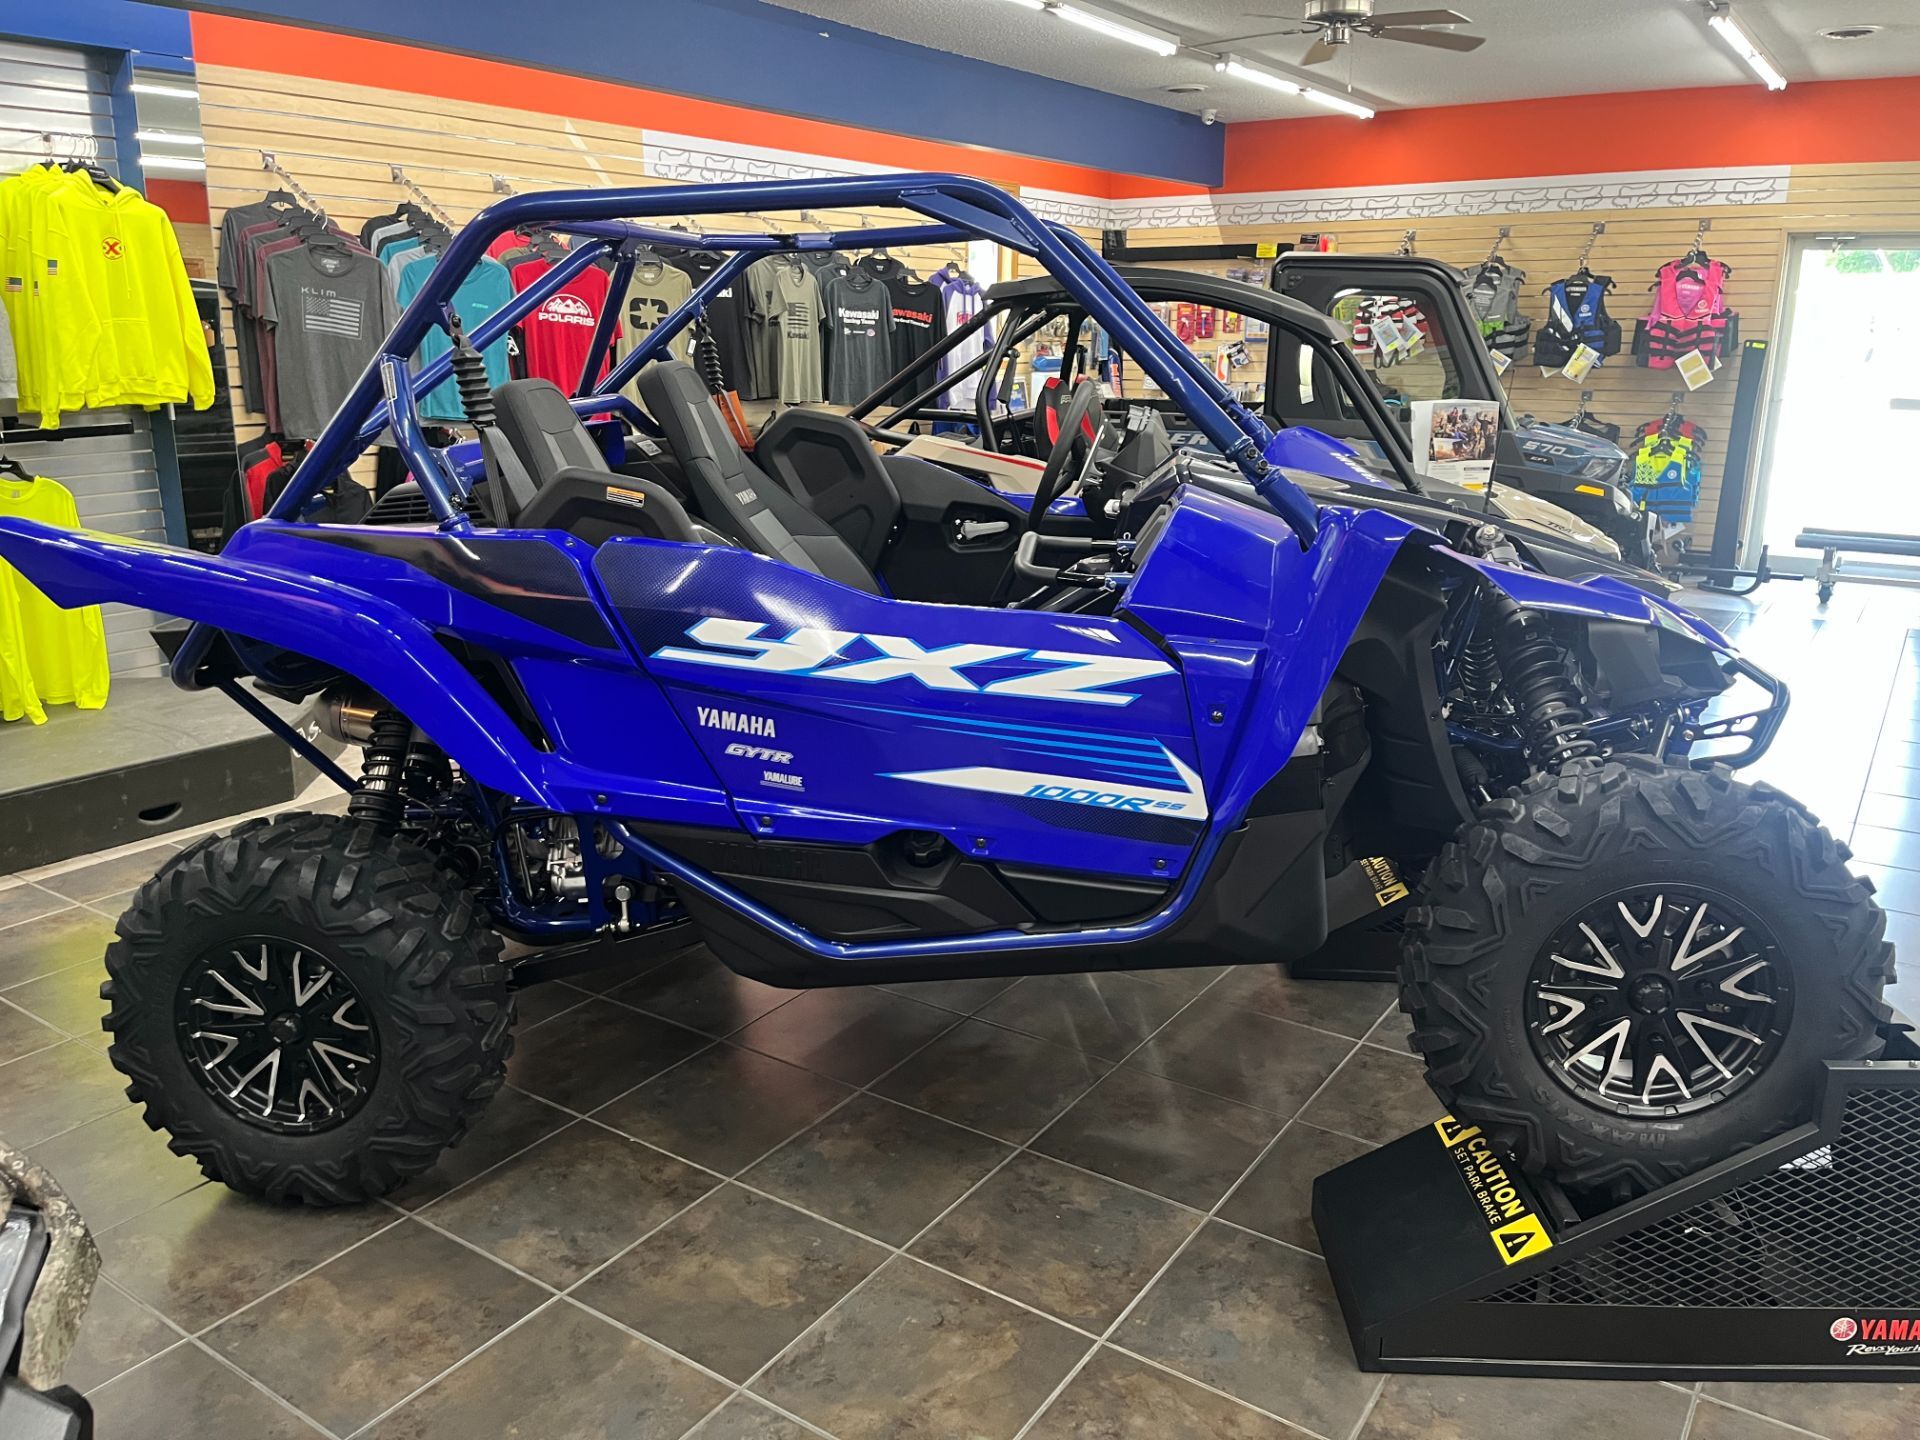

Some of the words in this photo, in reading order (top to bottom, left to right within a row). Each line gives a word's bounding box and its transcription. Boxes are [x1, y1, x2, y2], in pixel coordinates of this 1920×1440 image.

[301, 286, 337, 298] KLIM
[538, 311, 595, 327] POLARIS
[838, 307, 879, 320] Kawasaki
[892, 307, 934, 323] awasaki
[1523, 440, 1567, 455] 570
[648, 616, 1181, 707] YXZ
[697, 706, 776, 738] YAMAHA
[725, 742, 794, 765] GYTR
[763, 770, 803, 787] YAMALUBE
[1368, 856, 1398, 887] AUTION
[1454, 1147, 1470, 1164] SET
[1463, 1164, 1484, 1191] PARK
[1476, 1190, 1502, 1225] BRAKE
[1467, 1137, 1526, 1218] CAUTION
[1861, 1319, 1920, 1341] YAMA
